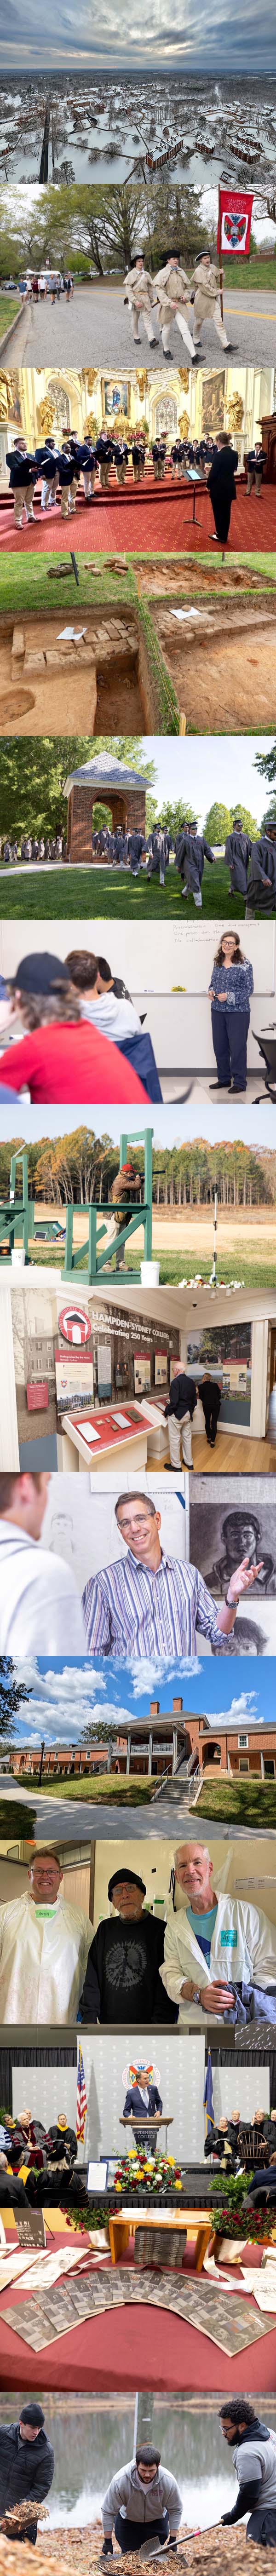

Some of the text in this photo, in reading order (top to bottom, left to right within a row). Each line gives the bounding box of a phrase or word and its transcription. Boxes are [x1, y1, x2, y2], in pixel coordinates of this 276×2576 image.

[60, 1307, 78, 1318] HUNDRED
[79, 1310, 88, 1320] FIFTY
[92, 1311, 169, 1339] HAMPDEN-SYDNEY COLLEGE
[92, 1322, 130, 1340] Celebrating
